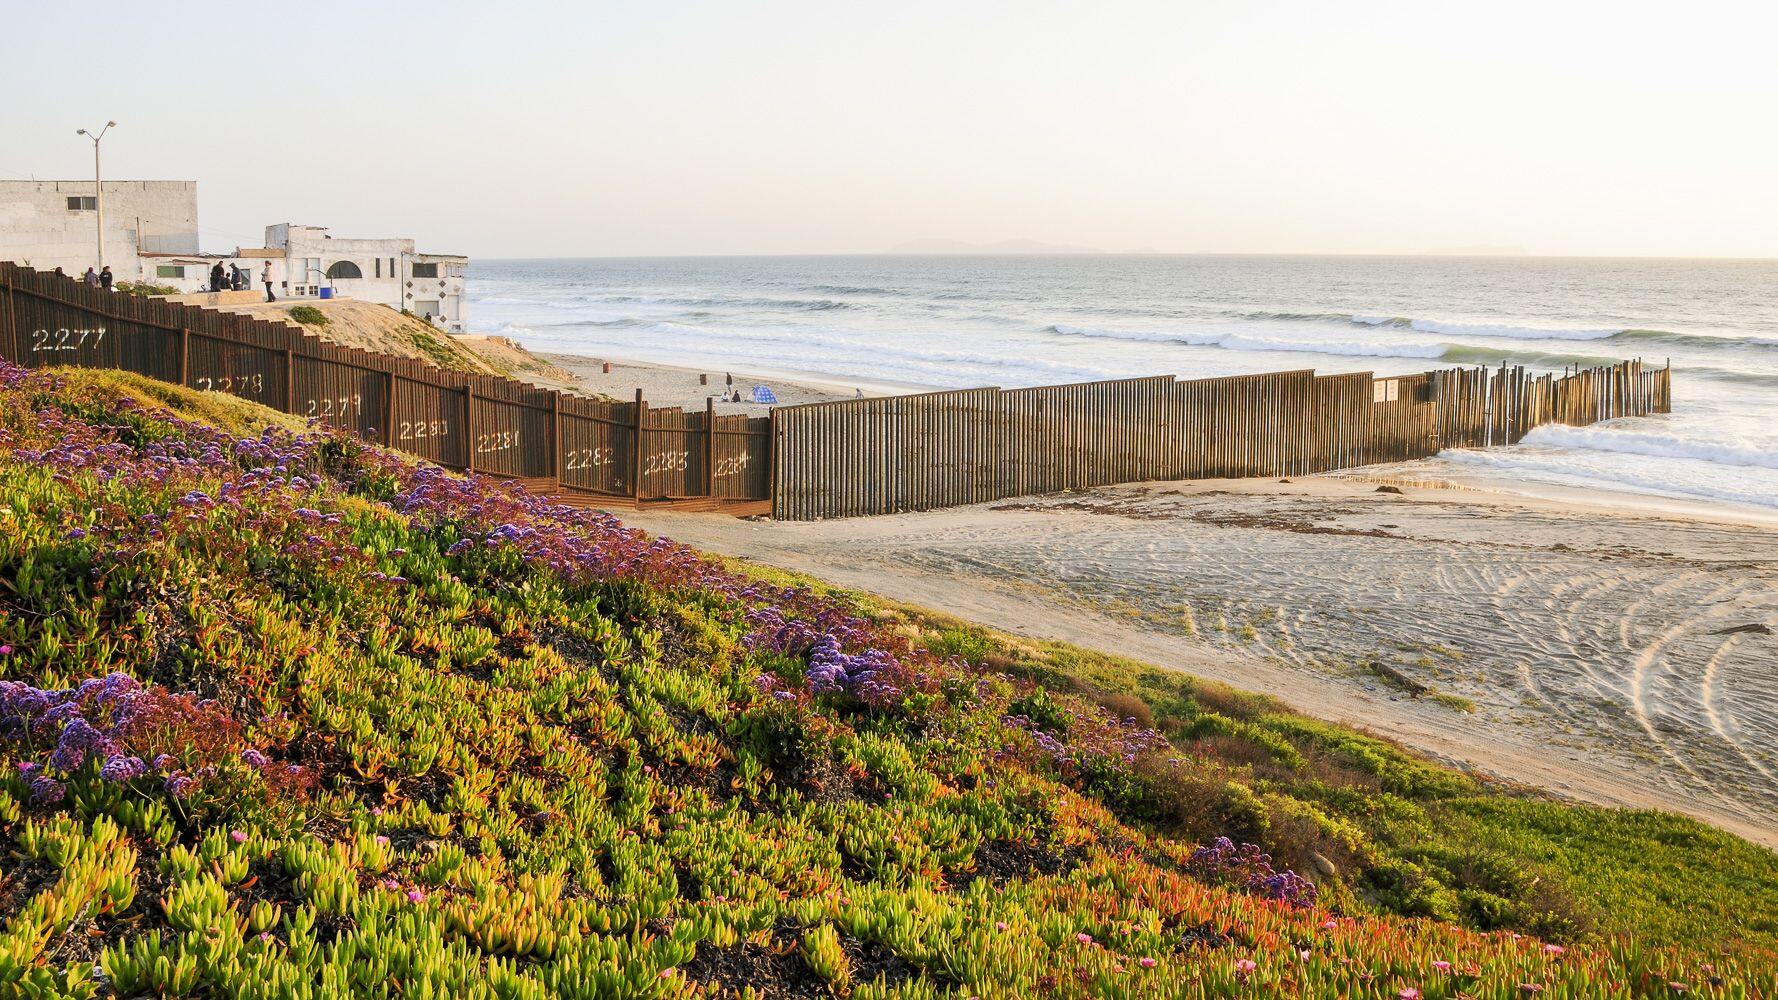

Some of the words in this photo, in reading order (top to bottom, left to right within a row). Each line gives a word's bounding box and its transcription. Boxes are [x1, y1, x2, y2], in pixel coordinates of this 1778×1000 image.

[33, 327, 106, 351] 2277
[307, 394, 361, 419] 2279
[477, 430, 519, 453] 2281
[567, 448, 615, 470] 2282
[645, 451, 689, 476] 2283
